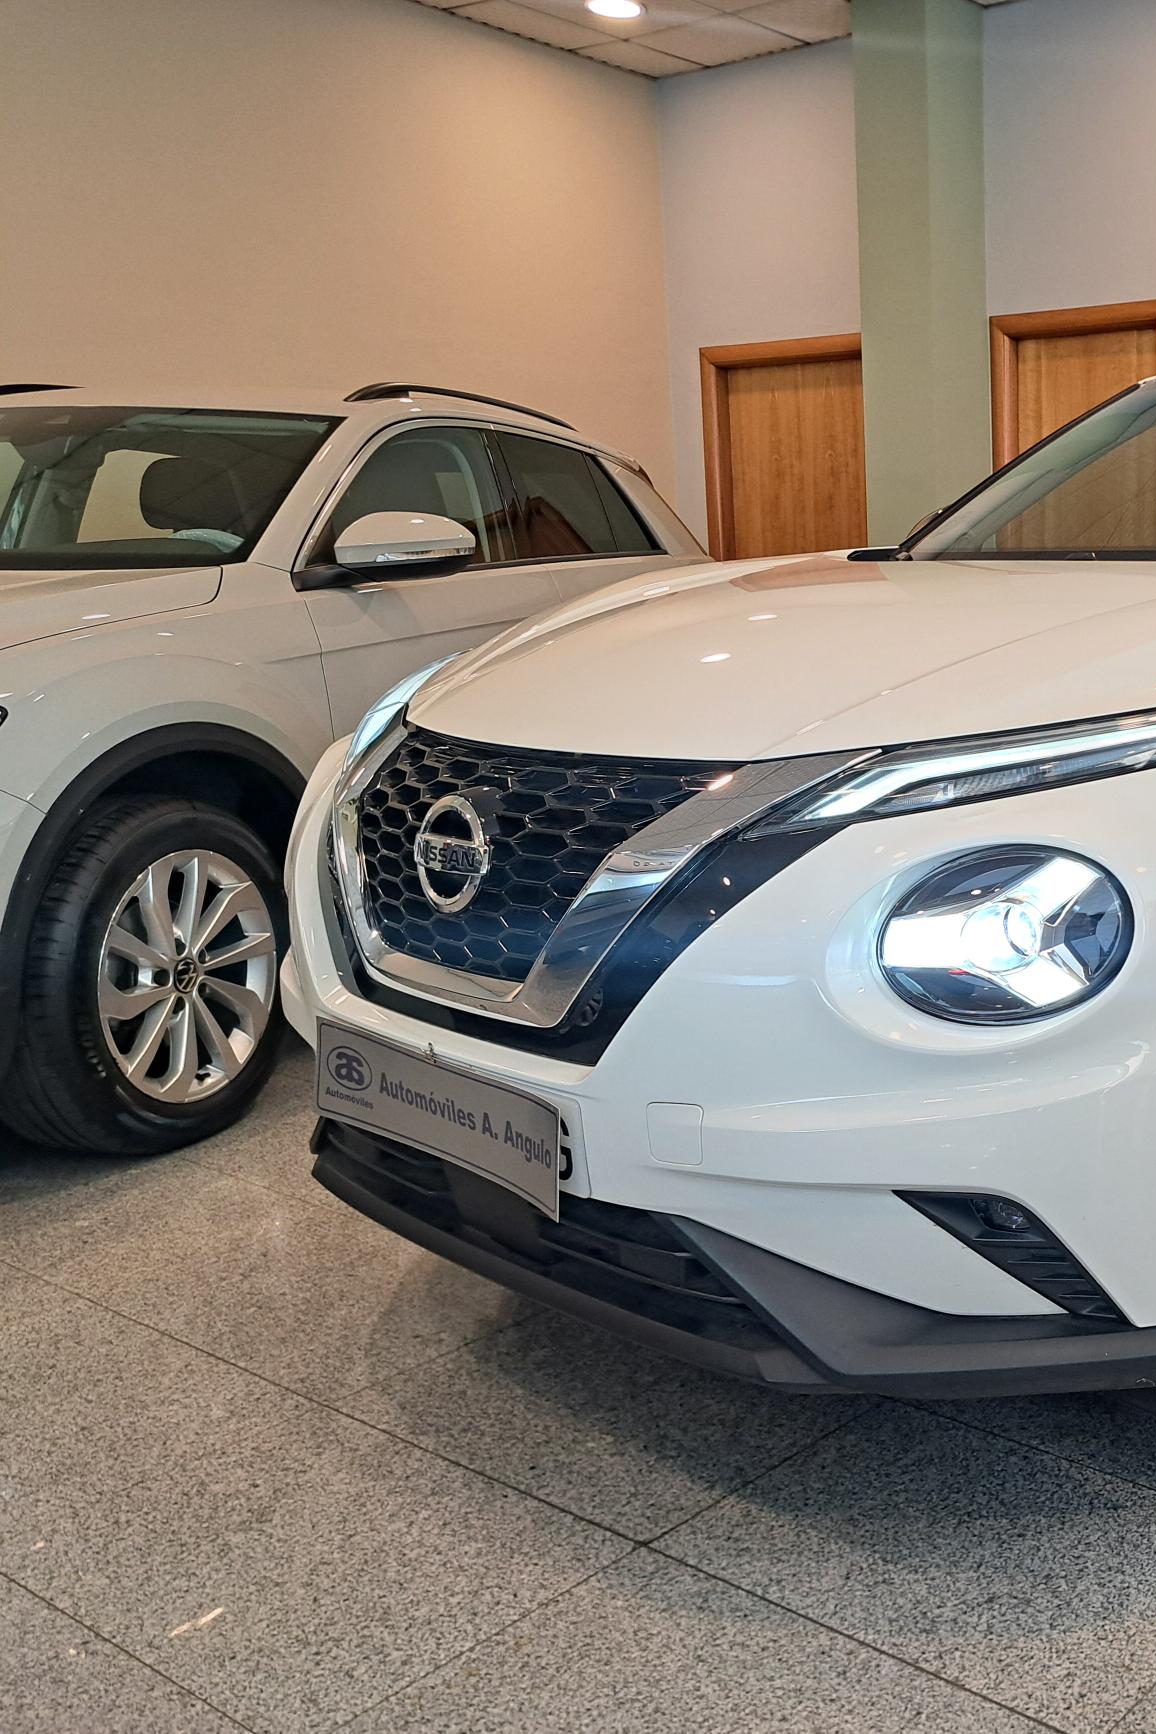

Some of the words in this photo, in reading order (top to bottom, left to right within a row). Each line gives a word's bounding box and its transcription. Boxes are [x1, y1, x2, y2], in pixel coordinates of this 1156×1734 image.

[380, 1072, 476, 1131] Automóviles
[482, 1112, 498, 1140] A.
[503, 1120, 552, 1169] Angulo
